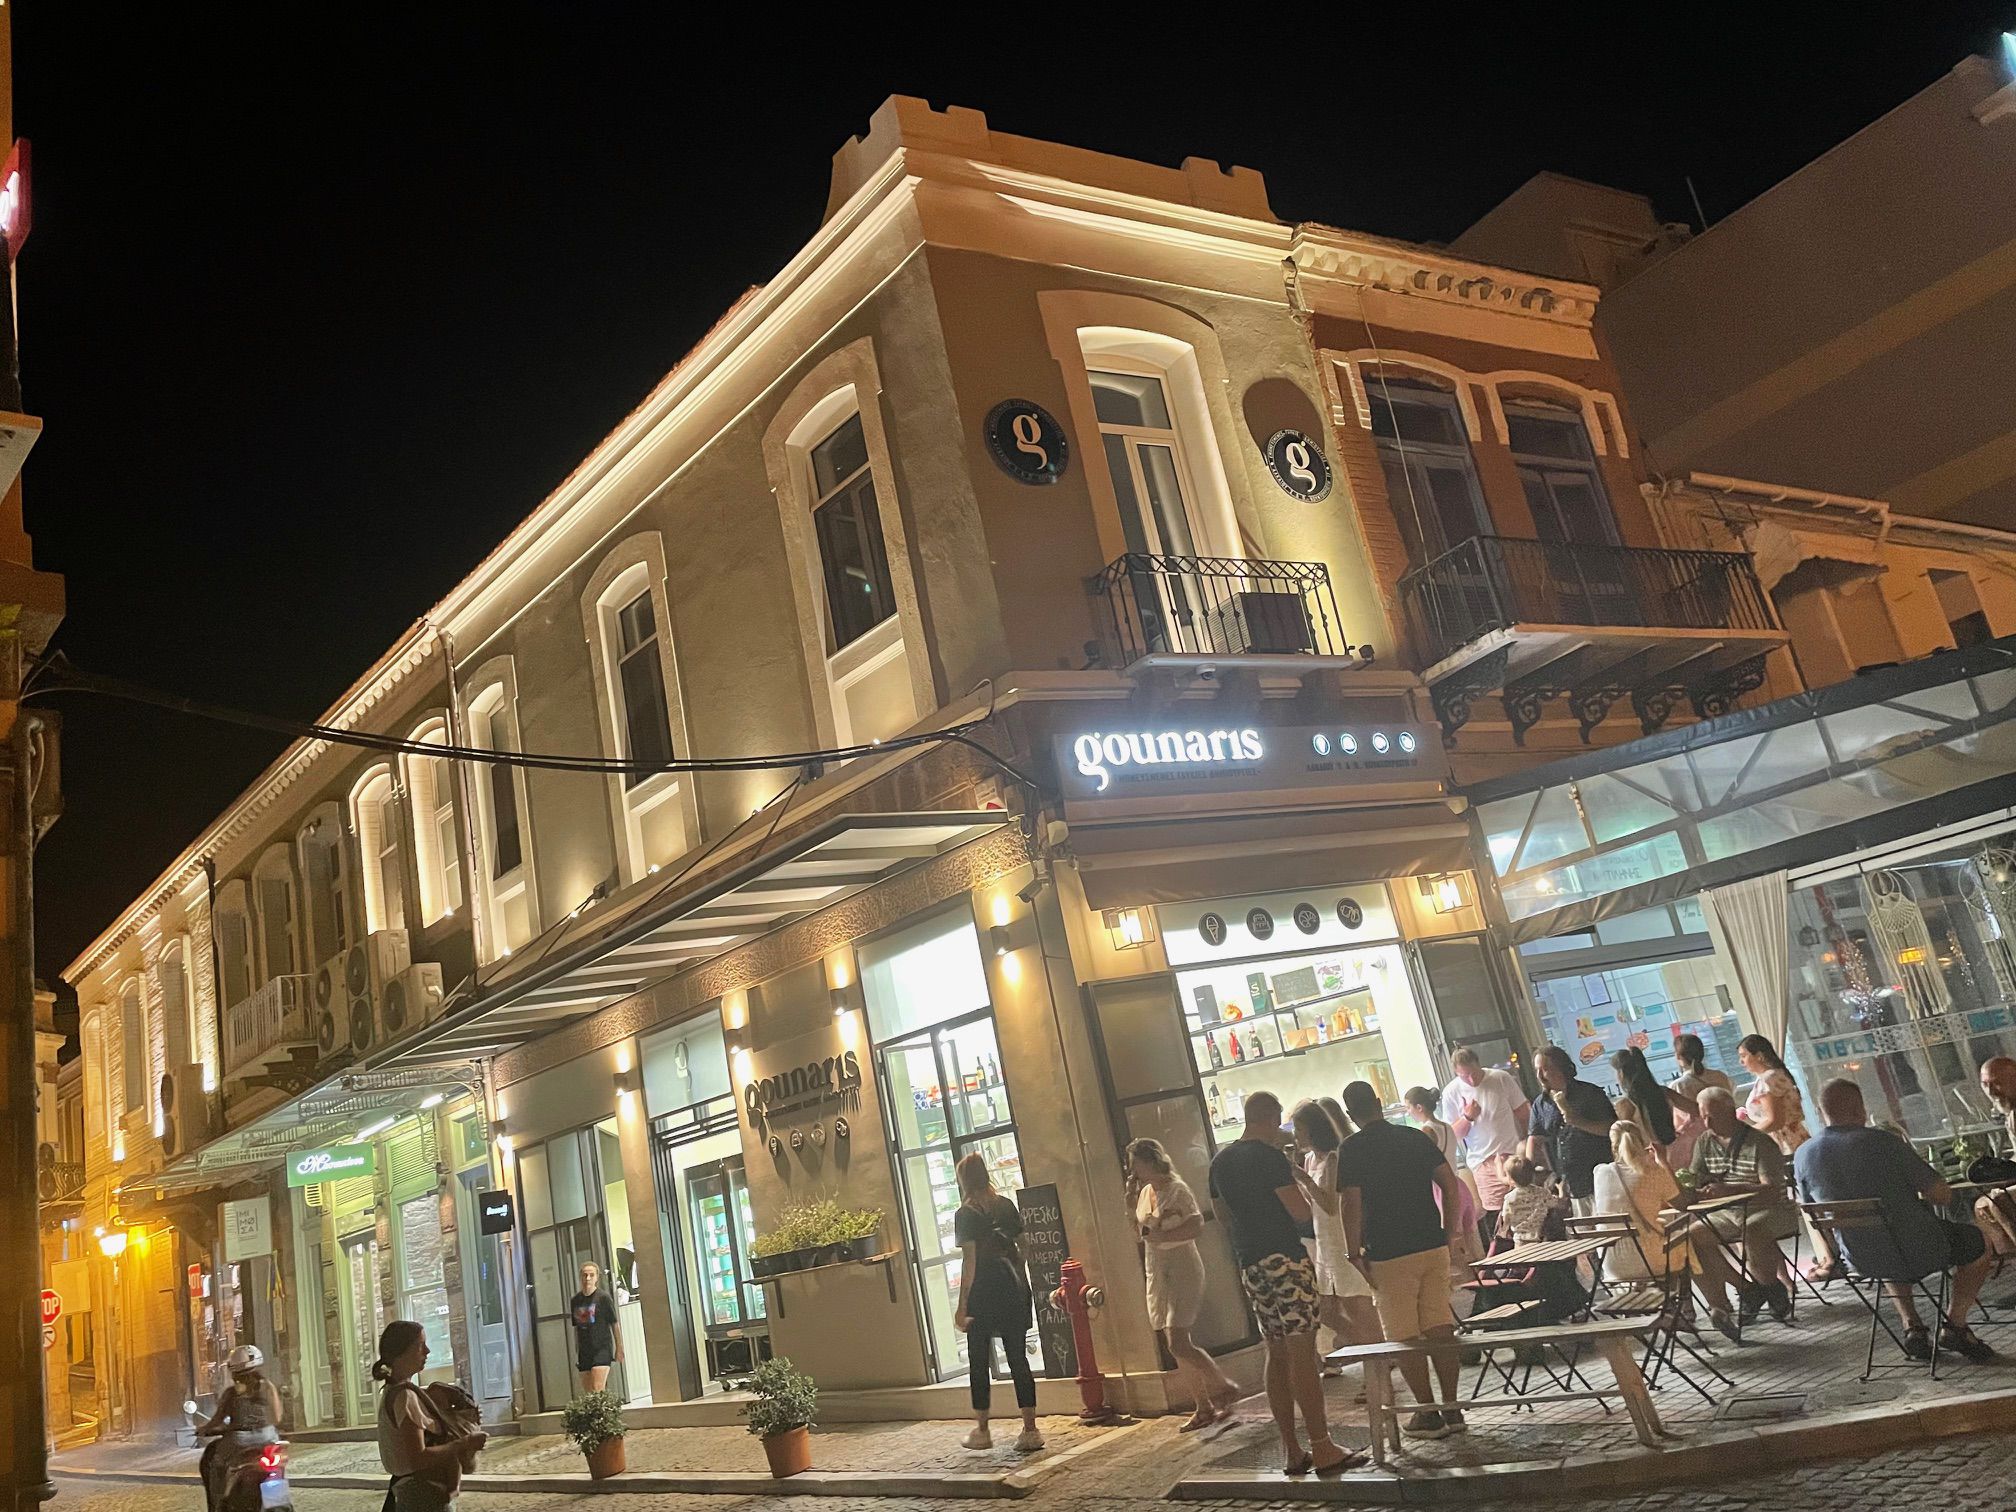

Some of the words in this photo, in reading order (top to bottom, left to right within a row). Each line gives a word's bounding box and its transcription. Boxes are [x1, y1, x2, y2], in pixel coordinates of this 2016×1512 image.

[1074, 728, 1264, 791] gounaris
[744, 1051, 861, 1120] gounaris
[1030, 1248, 1064, 1264] ΜΕΡΑΣ
[42, 1297, 59, 1316] OP
